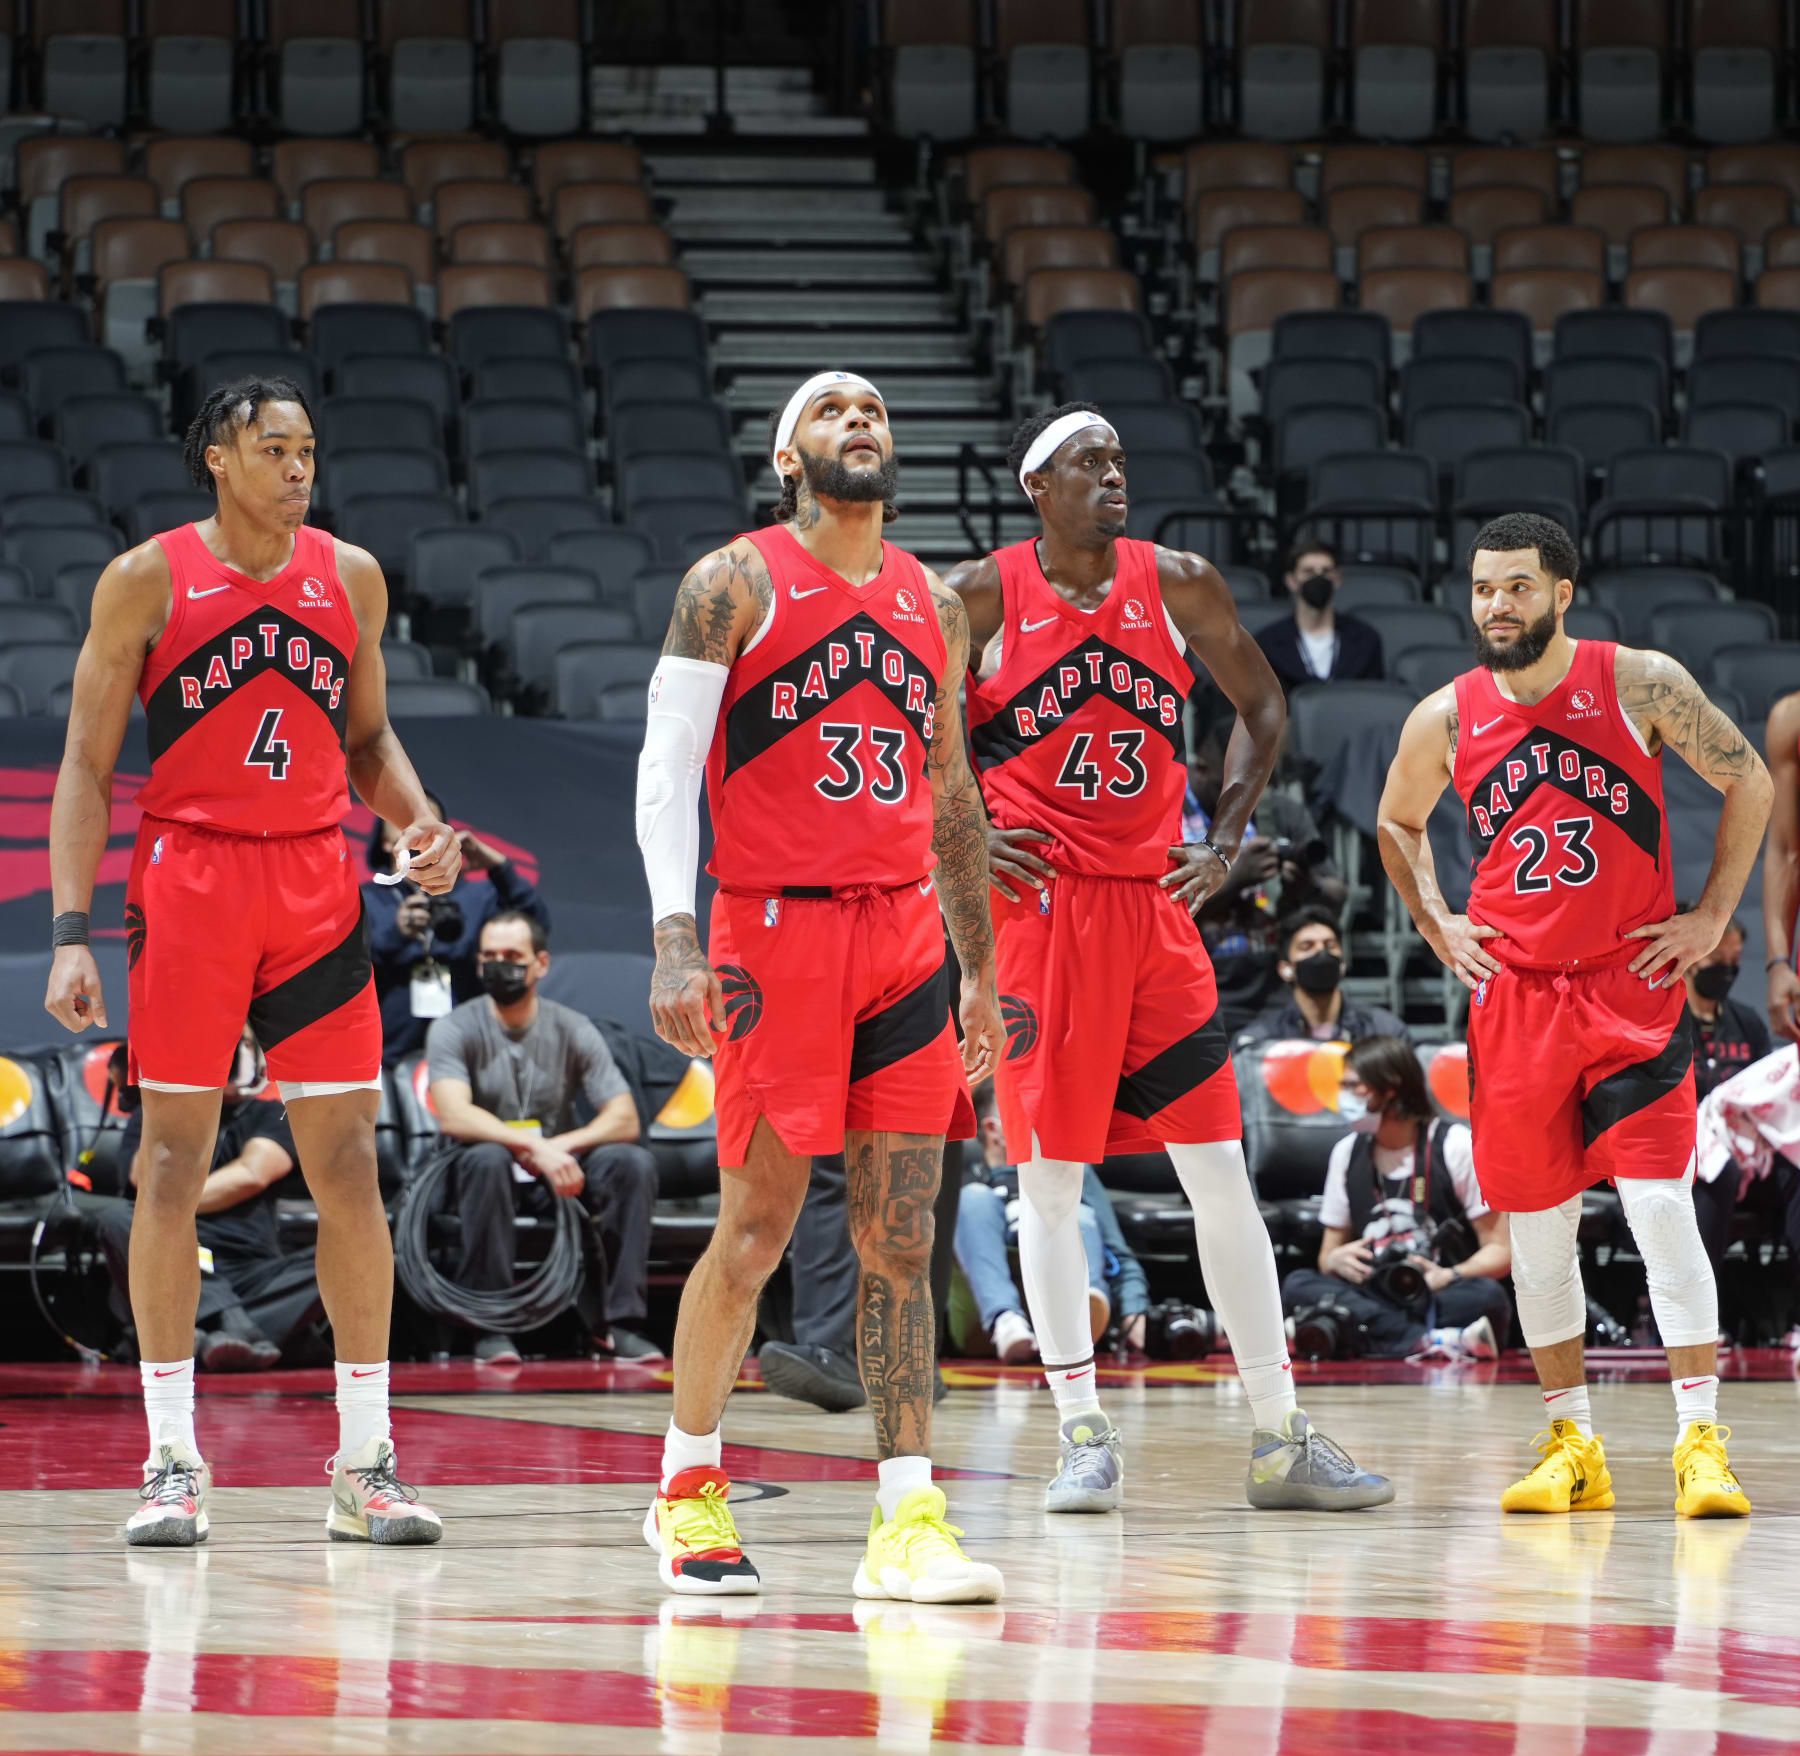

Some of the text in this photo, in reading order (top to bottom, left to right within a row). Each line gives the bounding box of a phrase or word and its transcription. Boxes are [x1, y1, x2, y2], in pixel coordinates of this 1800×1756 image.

[298, 599, 333, 608] Sun Life
[892, 610, 925, 624] Sun Life
[1120, 619, 1153, 629] Sun Life
[180, 624, 344, 709] RAPTORS
[772, 632, 935, 739] RAPTORS
[1015, 652, 1176, 736] RAPTORS
[244, 708, 291, 780] 4
[1566, 708, 1602, 721] Sun Life
[814, 722, 907, 804] 33
[1055, 730, 1148, 800] 43
[1472, 743, 1629, 836] RAPTORS
[1509, 816, 1598, 894] 23
[865, 1354, 886, 1388] THE
